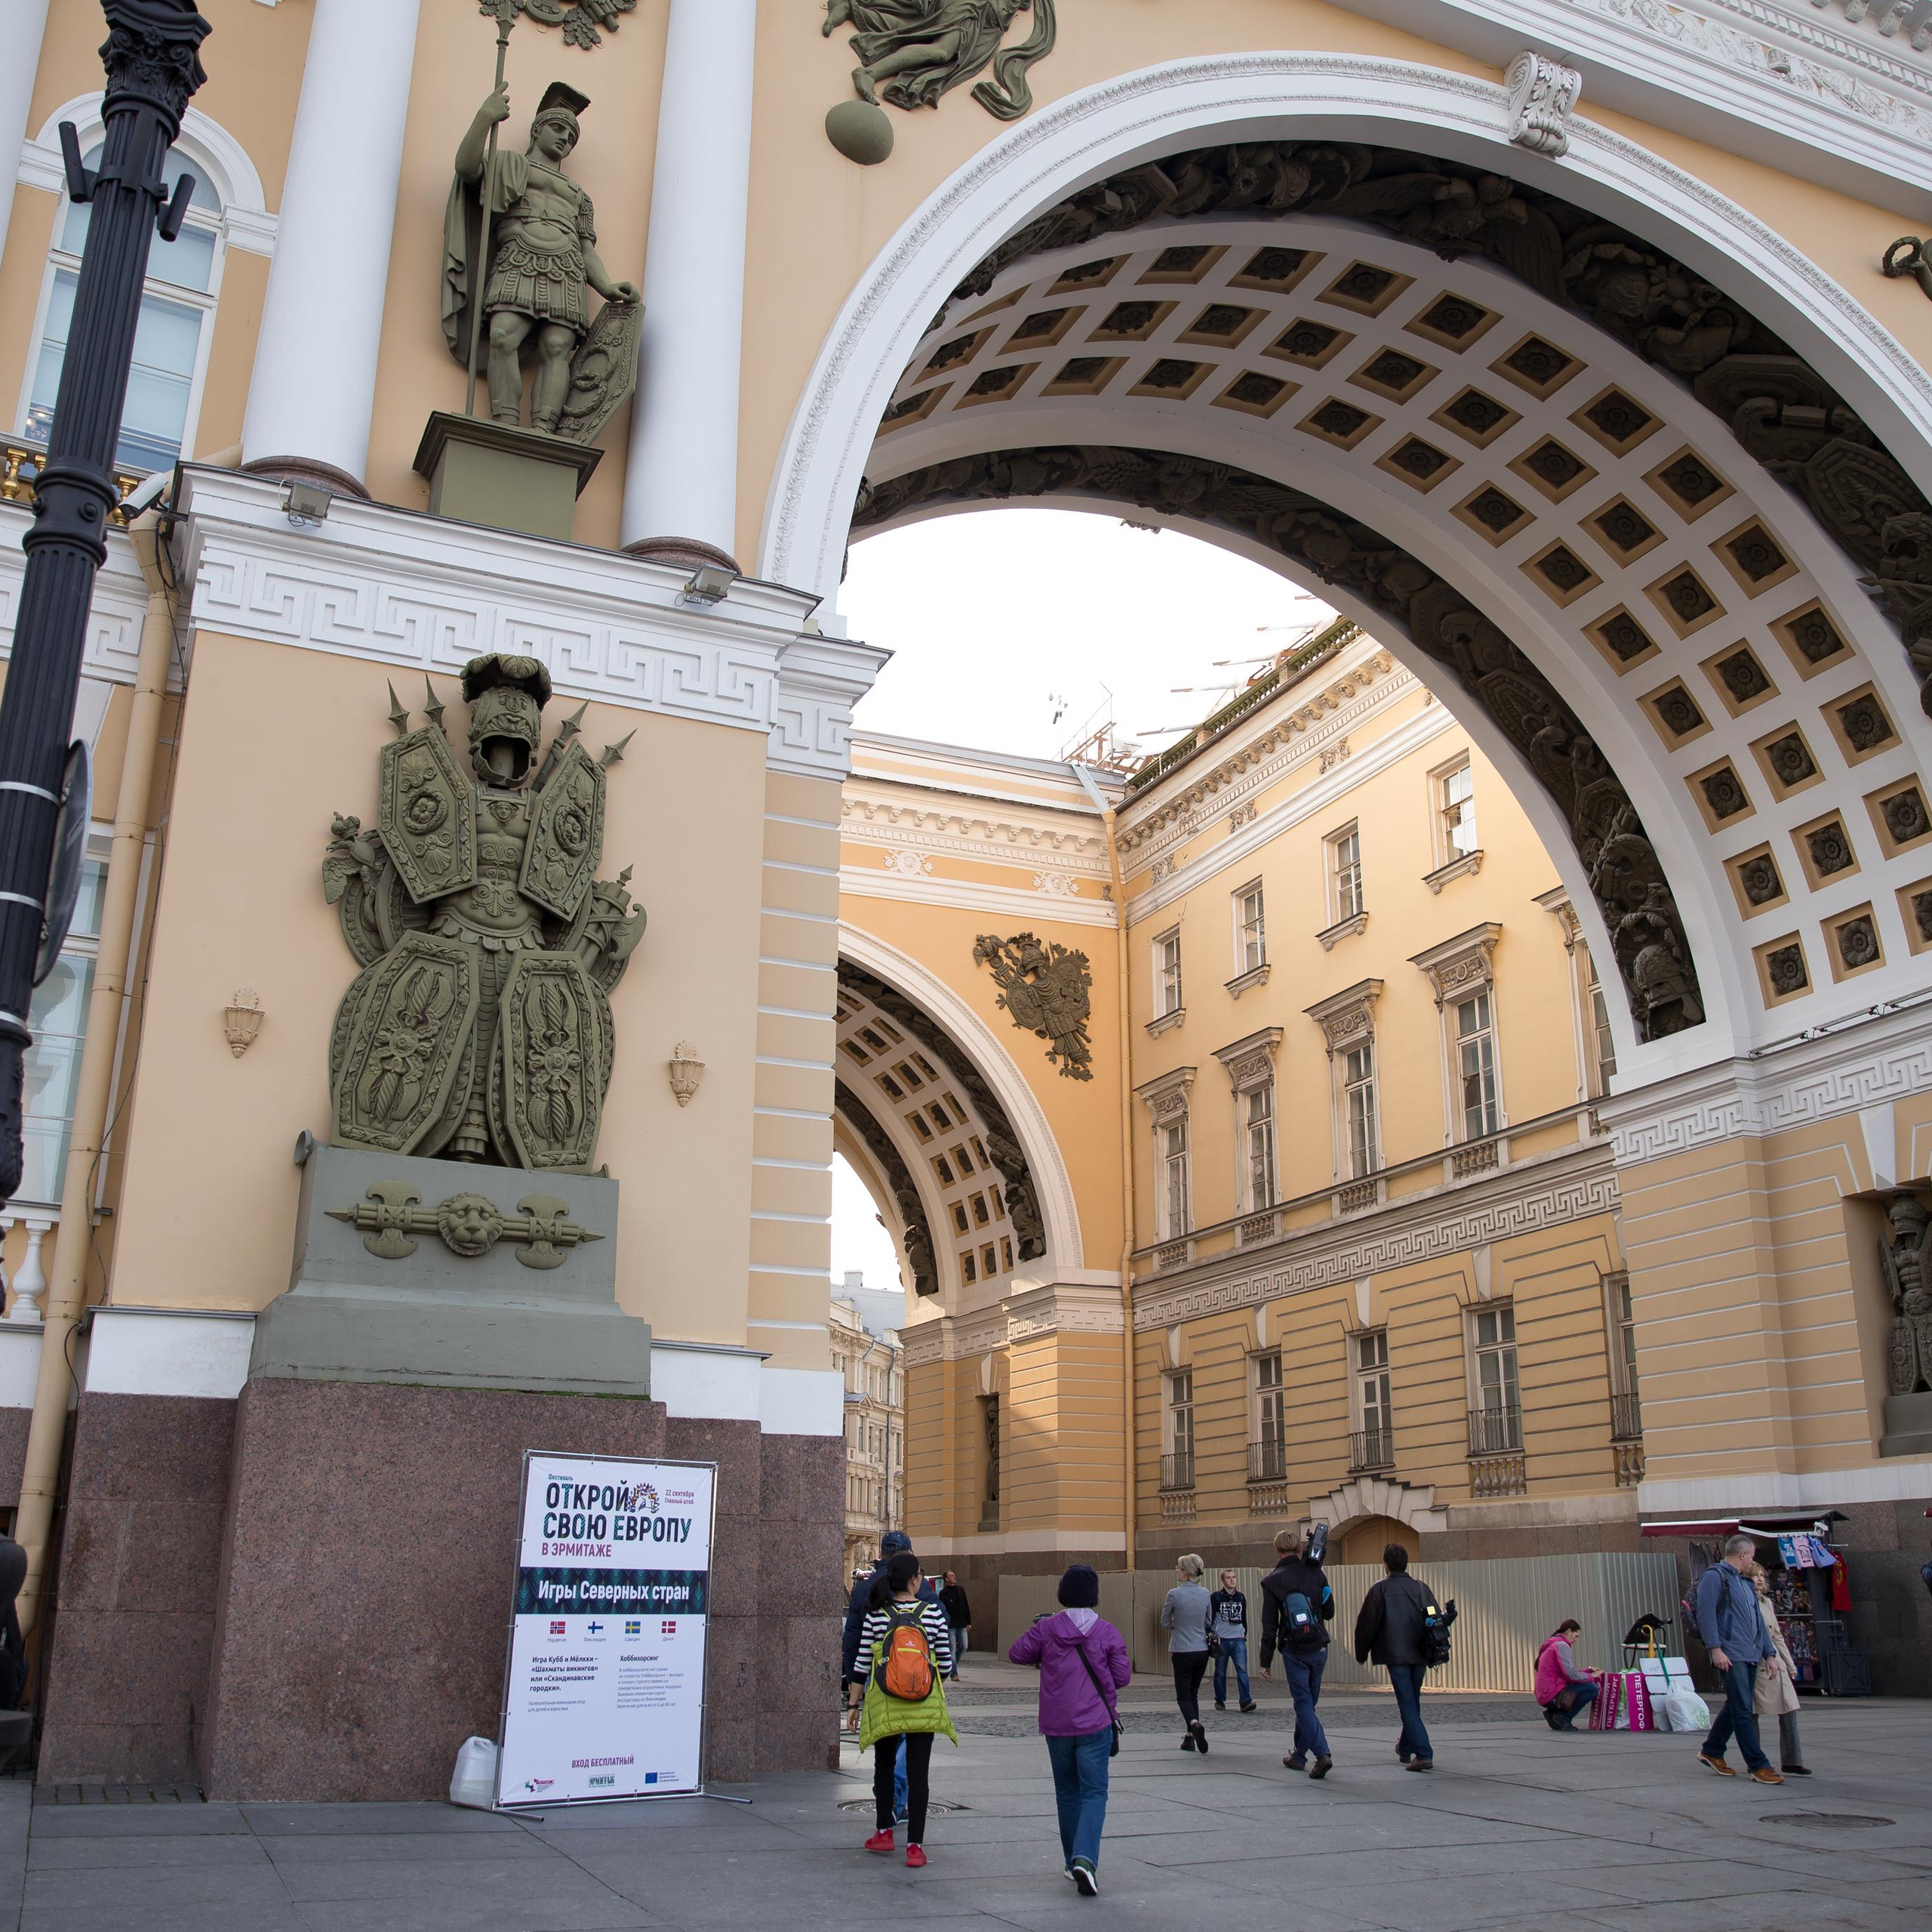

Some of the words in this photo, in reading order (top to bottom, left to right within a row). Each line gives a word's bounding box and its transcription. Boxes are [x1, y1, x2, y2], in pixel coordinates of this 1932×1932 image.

[548, 1473, 574, 1481] Фестиваль
[546, 1480, 629, 1512] ОТКРОЙ
[543, 1512, 607, 1540] СВОЮ
[613, 1515, 692, 1543] ЕВРОПУ
[542, 1543, 549, 1555] В
[552, 1543, 611, 1557] ЭРМИТАЖЕ
[538, 1580, 576, 1604] Игры
[580, 1580, 649, 1604] Северных
[652, 1586, 690, 1604] стран
[1606, 1675, 1618, 1727] ПЕТЕРБУРГ
[1634, 1675, 1645, 1730] ПЕТЕРГОФ
[571, 1759, 589, 1768] ВХОД
[591, 1754, 635, 1767] БЕСПЛАТНЫЙ
